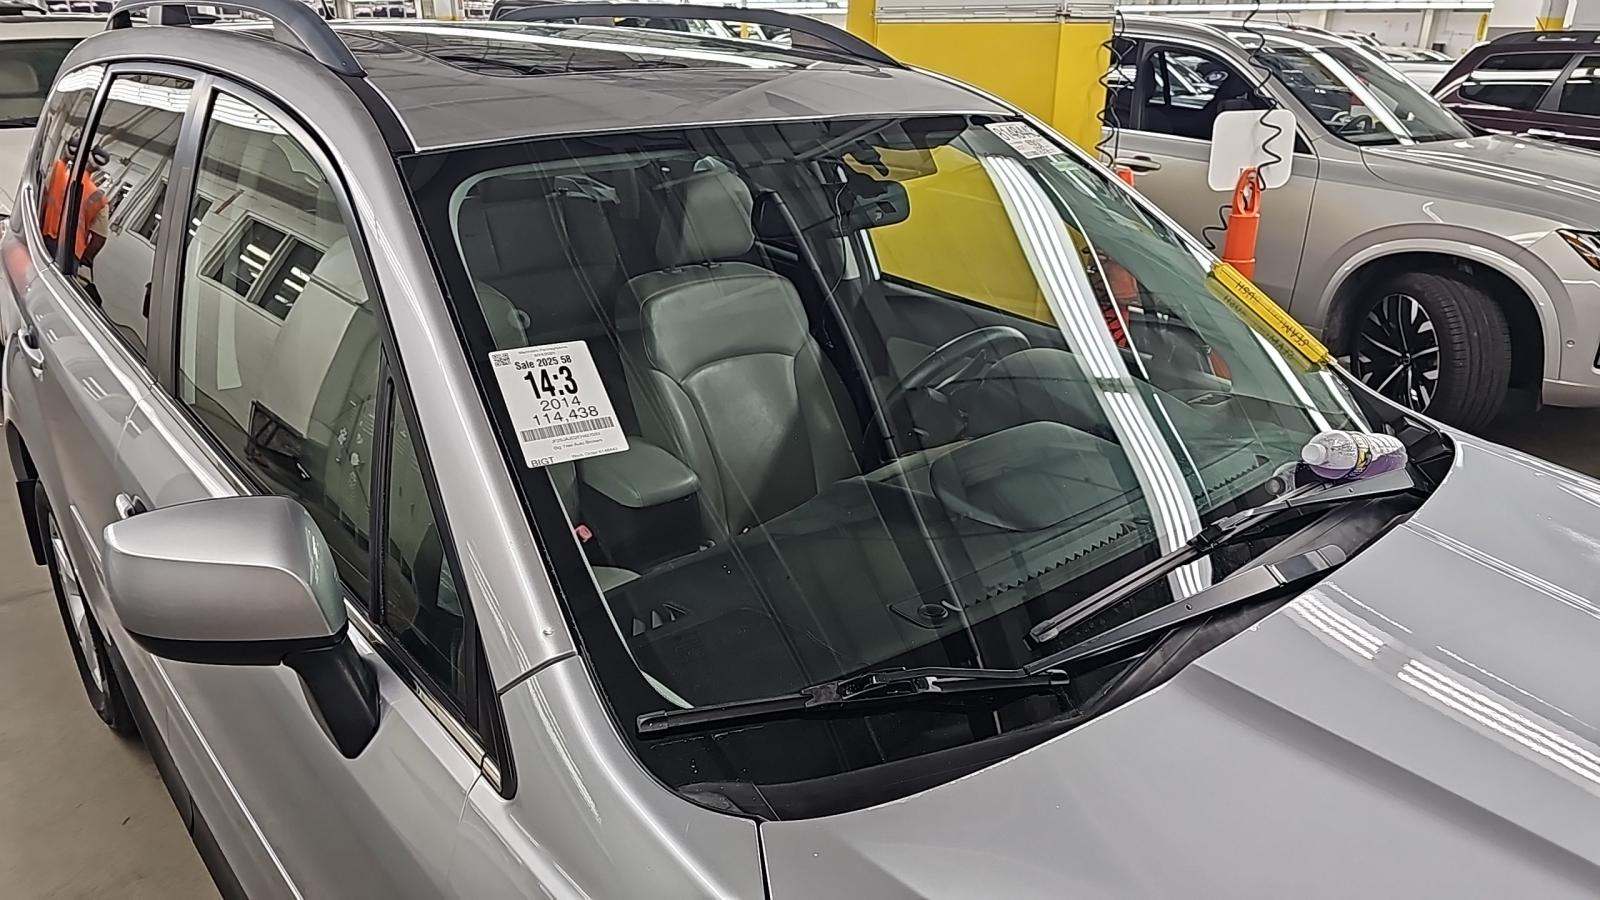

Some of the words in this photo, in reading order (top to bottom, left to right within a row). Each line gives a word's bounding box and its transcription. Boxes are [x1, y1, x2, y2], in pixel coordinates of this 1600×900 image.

[515, 361, 535, 371] Sale
[537, 357, 559, 367] 2025
[561, 355, 572, 364] 58
[524, 366, 578, 399] 14:3
[540, 396, 581, 411] 2014
[533, 406, 599, 426] 114,438
[531, 457, 554, 468] BIGT
